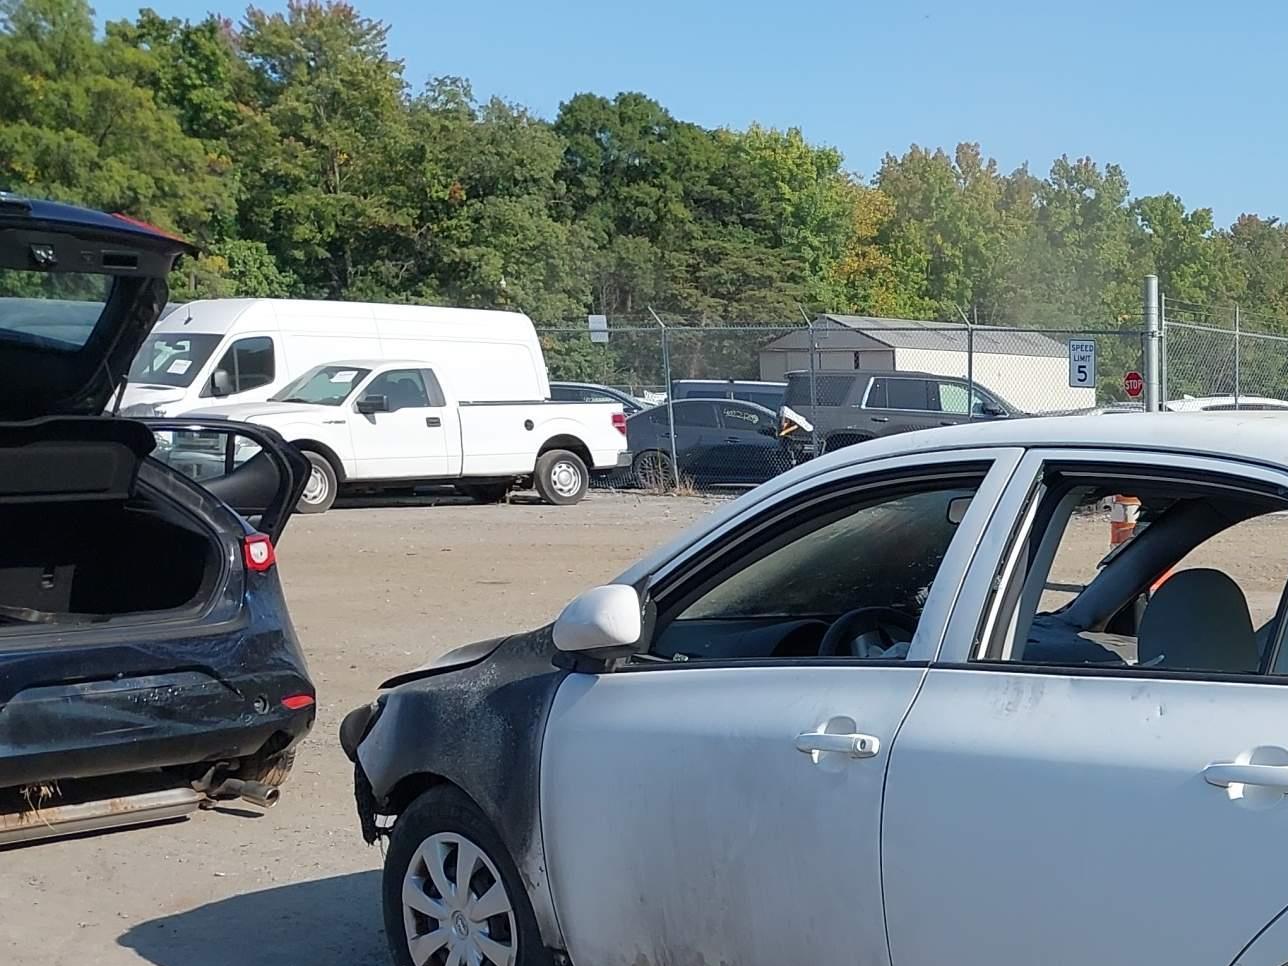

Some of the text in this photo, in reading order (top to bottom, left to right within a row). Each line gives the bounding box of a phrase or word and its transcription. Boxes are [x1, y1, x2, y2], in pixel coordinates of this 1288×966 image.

[1072, 344, 1094, 352] SPEED
[1073, 354, 1091, 362] LIMIT
[1077, 365, 1088, 382] 5
[1125, 380, 1142, 390] STOP
